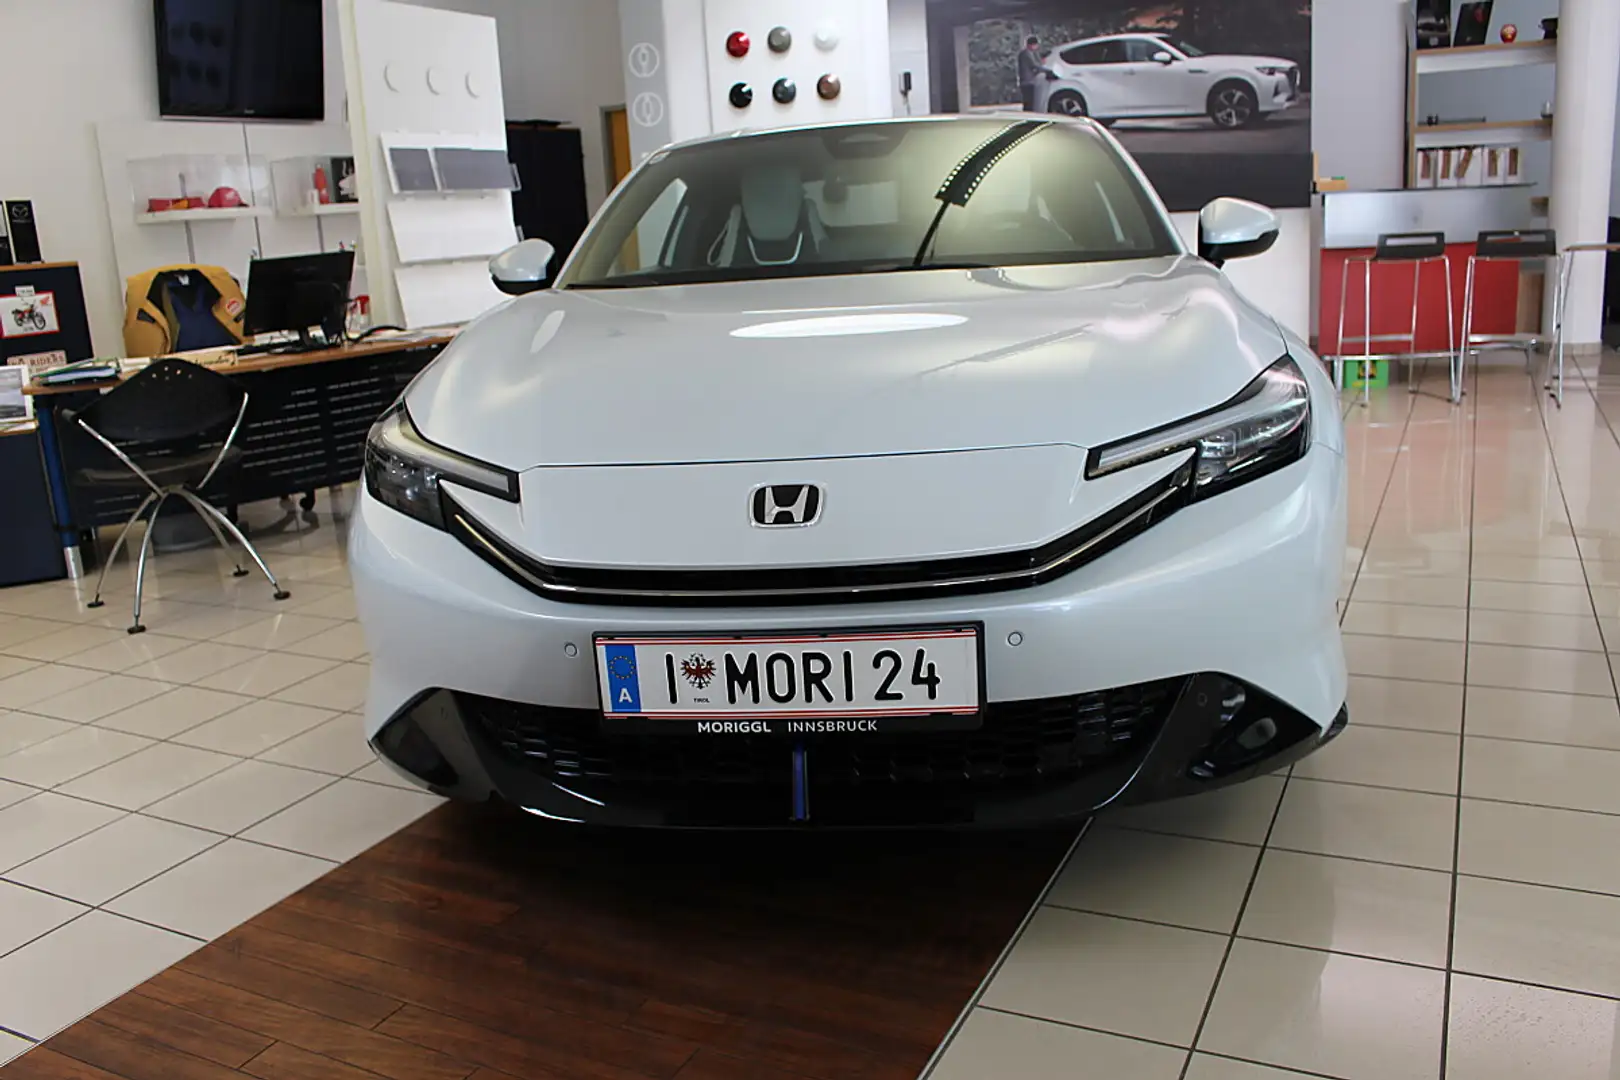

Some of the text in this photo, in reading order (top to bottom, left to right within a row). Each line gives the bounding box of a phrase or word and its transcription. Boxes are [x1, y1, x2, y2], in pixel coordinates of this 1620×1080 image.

[665, 648, 940, 704] I MORI 24
[618, 687, 633, 703] A
[697, 719, 877, 733] MORIGGL INNSBRUCK
